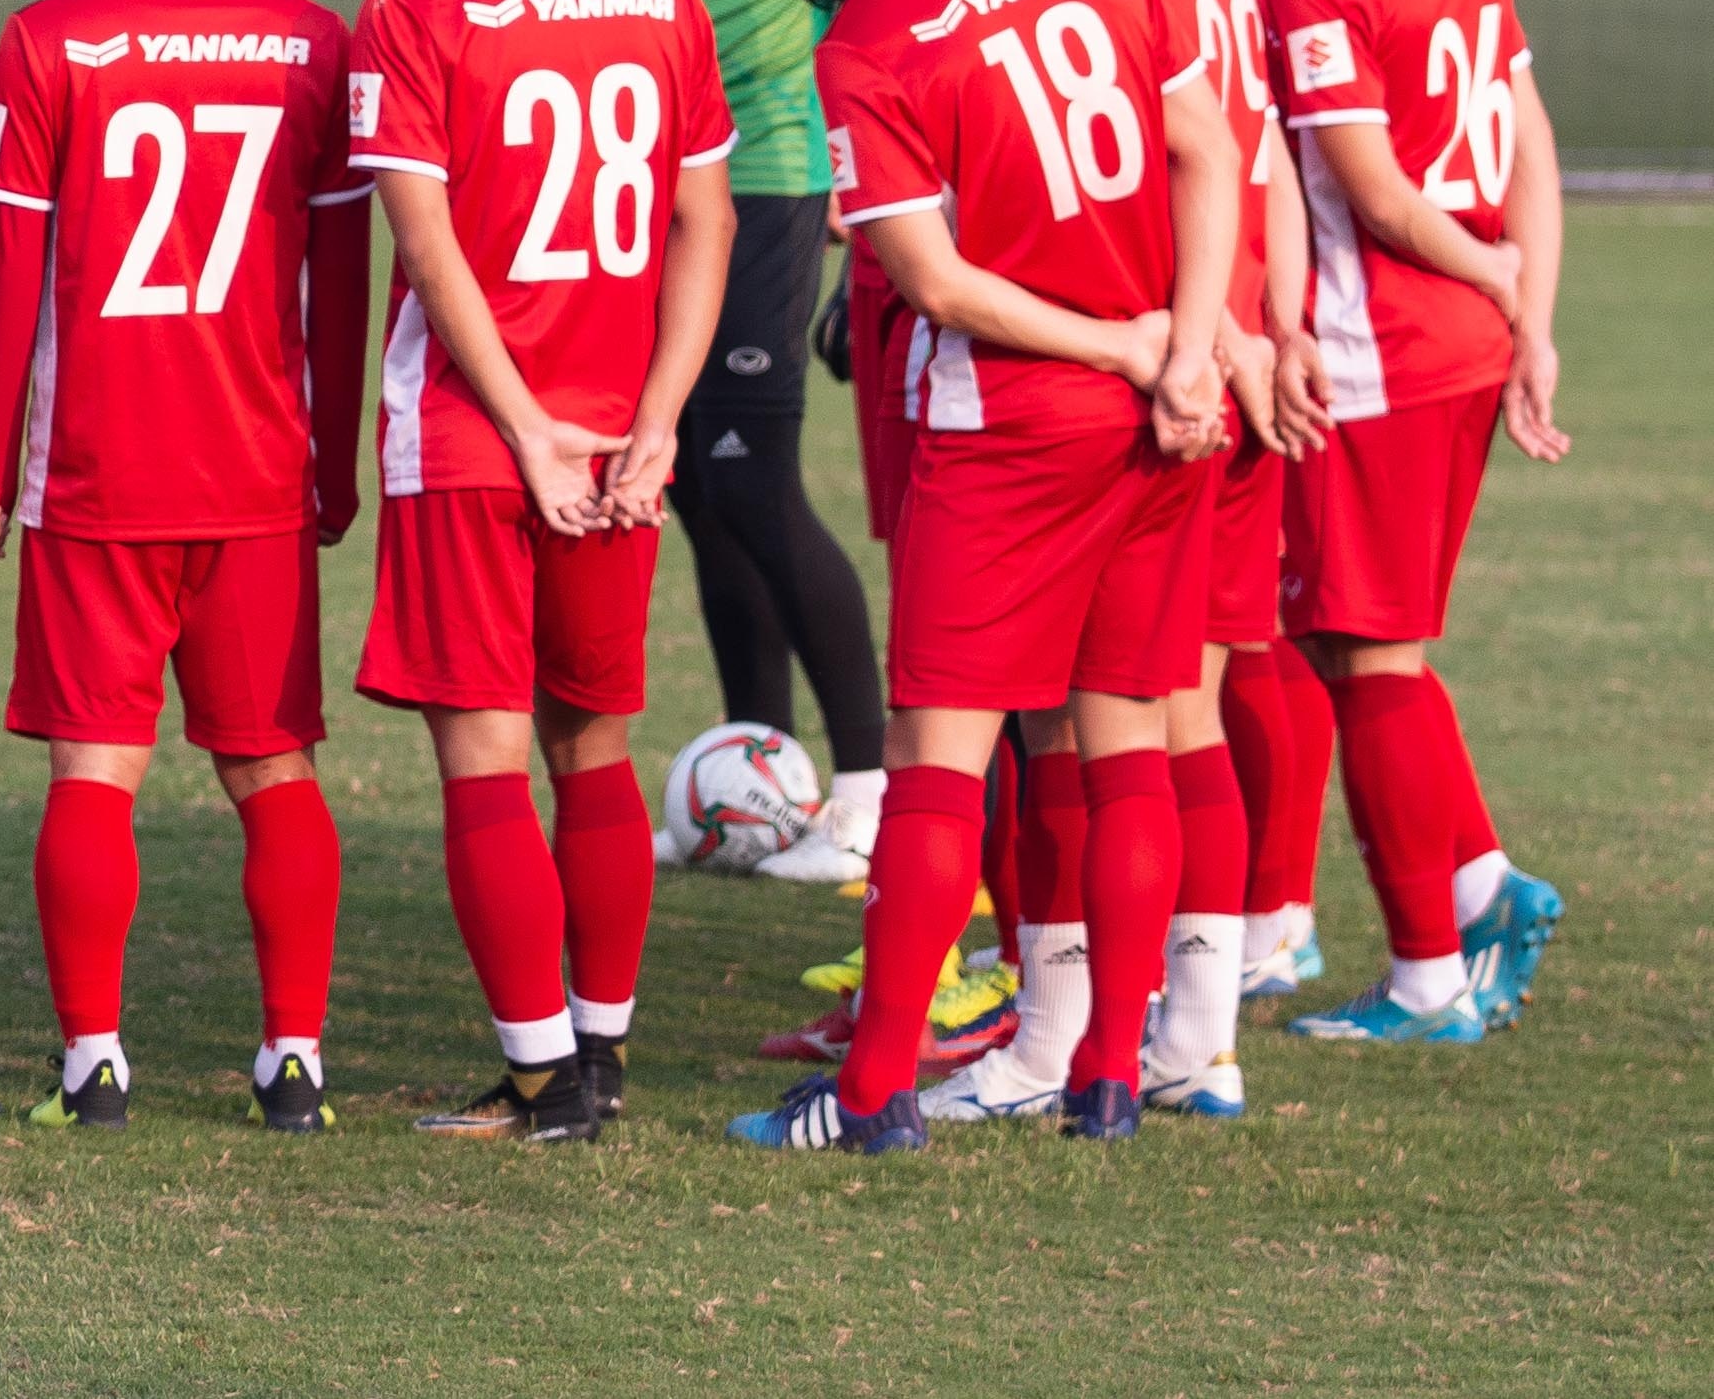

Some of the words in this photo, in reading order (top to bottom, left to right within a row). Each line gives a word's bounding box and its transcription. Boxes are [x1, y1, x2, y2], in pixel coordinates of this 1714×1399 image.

[137, 33, 310, 65] YANMAR
[977, 0, 1145, 222] 18
[1421, 2, 1515, 212] 26
[100, 101, 284, 318] 27
[503, 62, 661, 282] 28
